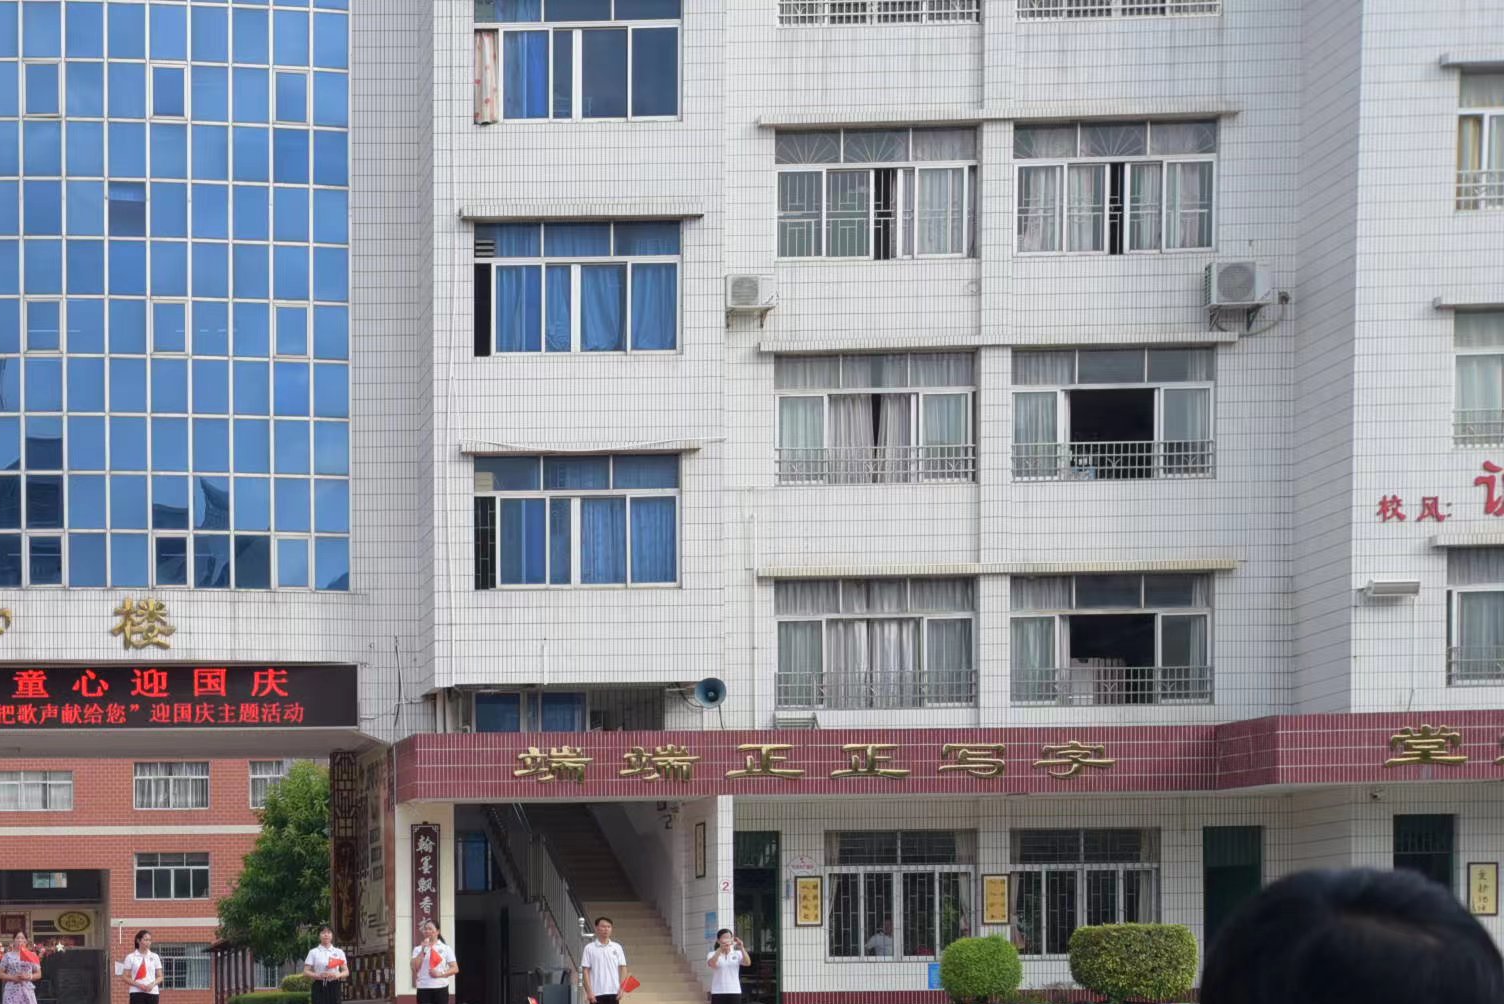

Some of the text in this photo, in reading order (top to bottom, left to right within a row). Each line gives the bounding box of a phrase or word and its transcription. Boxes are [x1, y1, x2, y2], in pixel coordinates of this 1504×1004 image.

[11, 668, 289, 698] 童心迎国庆
[514, 741, 1117, 784] 端端正正写字
[1383, 723, 1504, 766] 堂
[722, 881, 730, 892] 2
